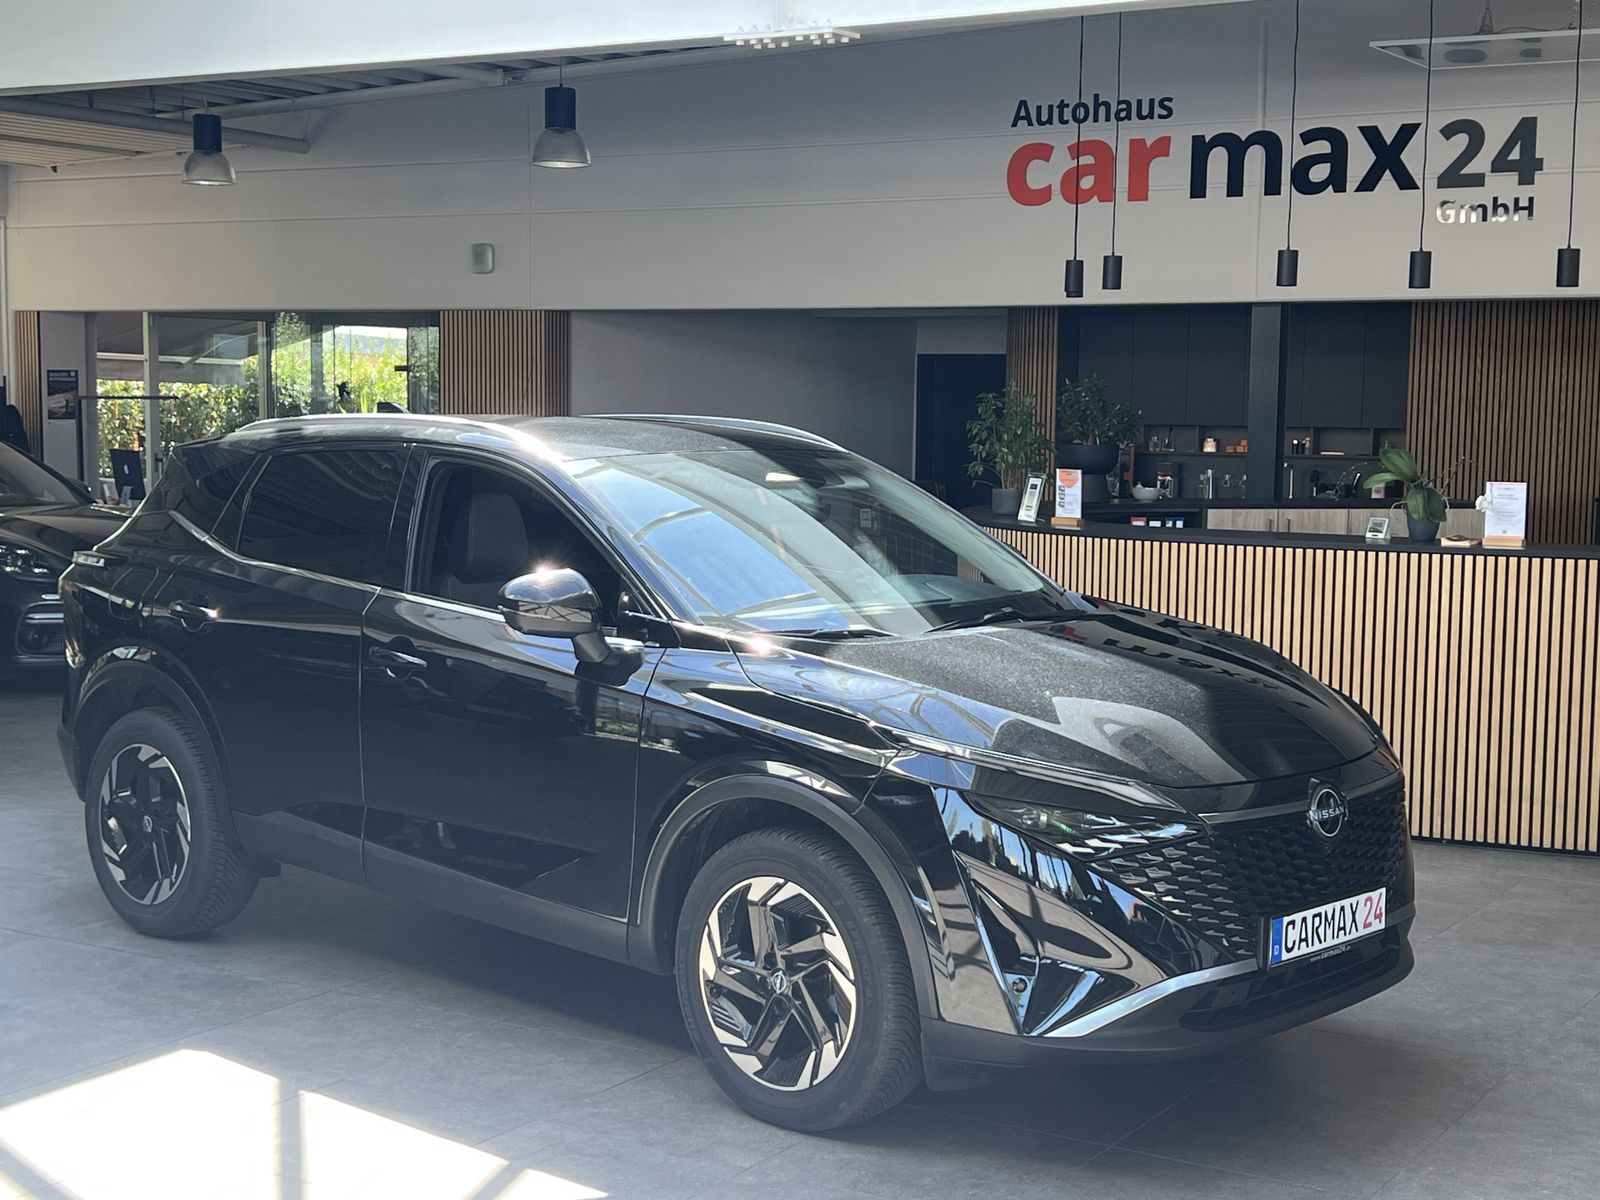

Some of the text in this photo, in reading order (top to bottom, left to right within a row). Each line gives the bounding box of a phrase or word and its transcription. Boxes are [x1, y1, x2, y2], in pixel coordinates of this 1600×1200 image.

[1011, 93, 1173, 128] Autohaus
[1435, 196, 1535, 224] GmbH
[1309, 805, 1345, 820] NISSAN
